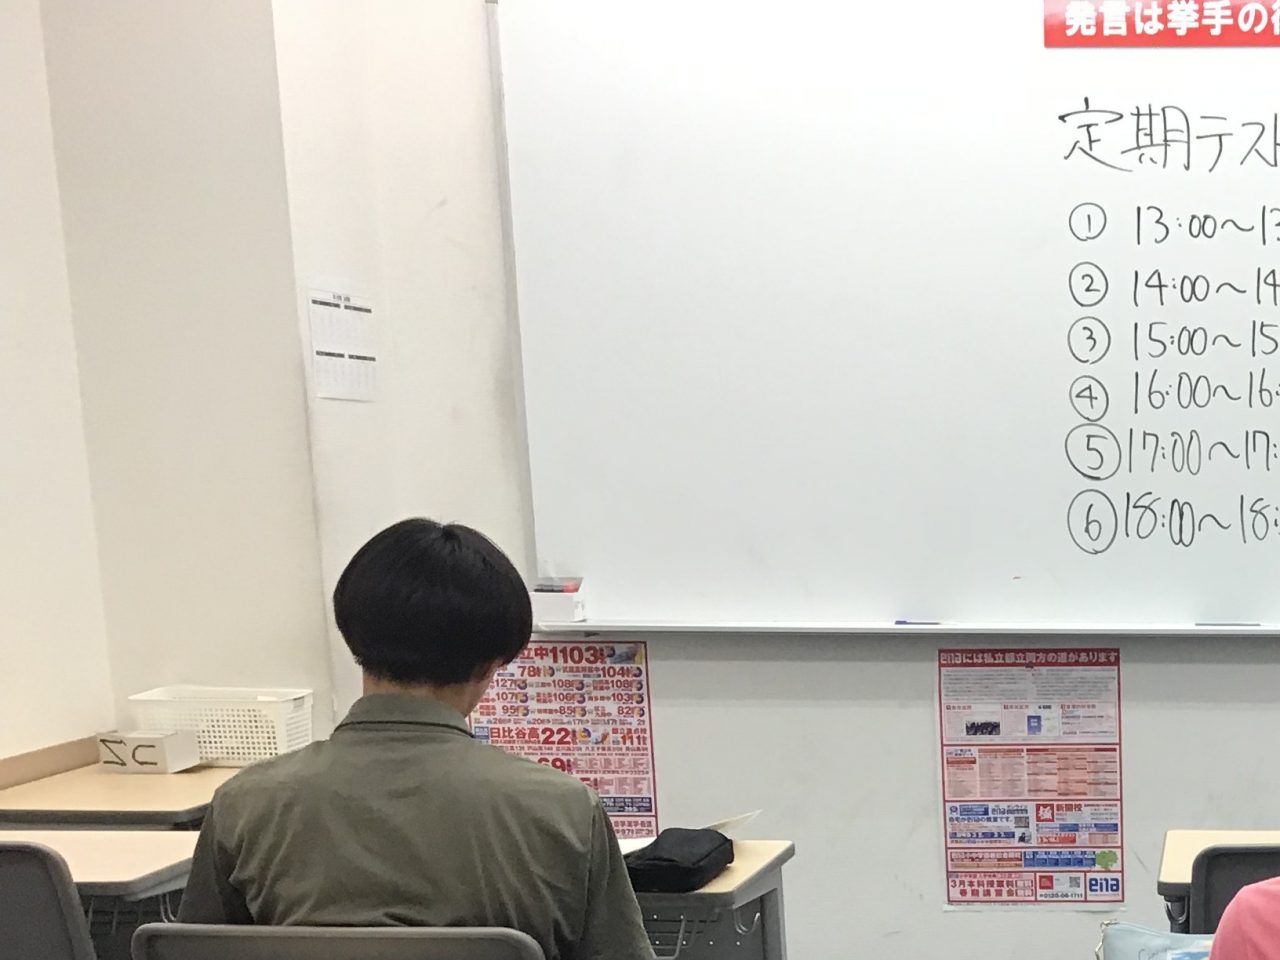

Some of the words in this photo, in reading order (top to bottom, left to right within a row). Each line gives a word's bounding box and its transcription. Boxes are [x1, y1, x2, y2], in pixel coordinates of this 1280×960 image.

[490, 727, 540, 739] 日比谷高
[1088, 877, 1120, 893] ena
